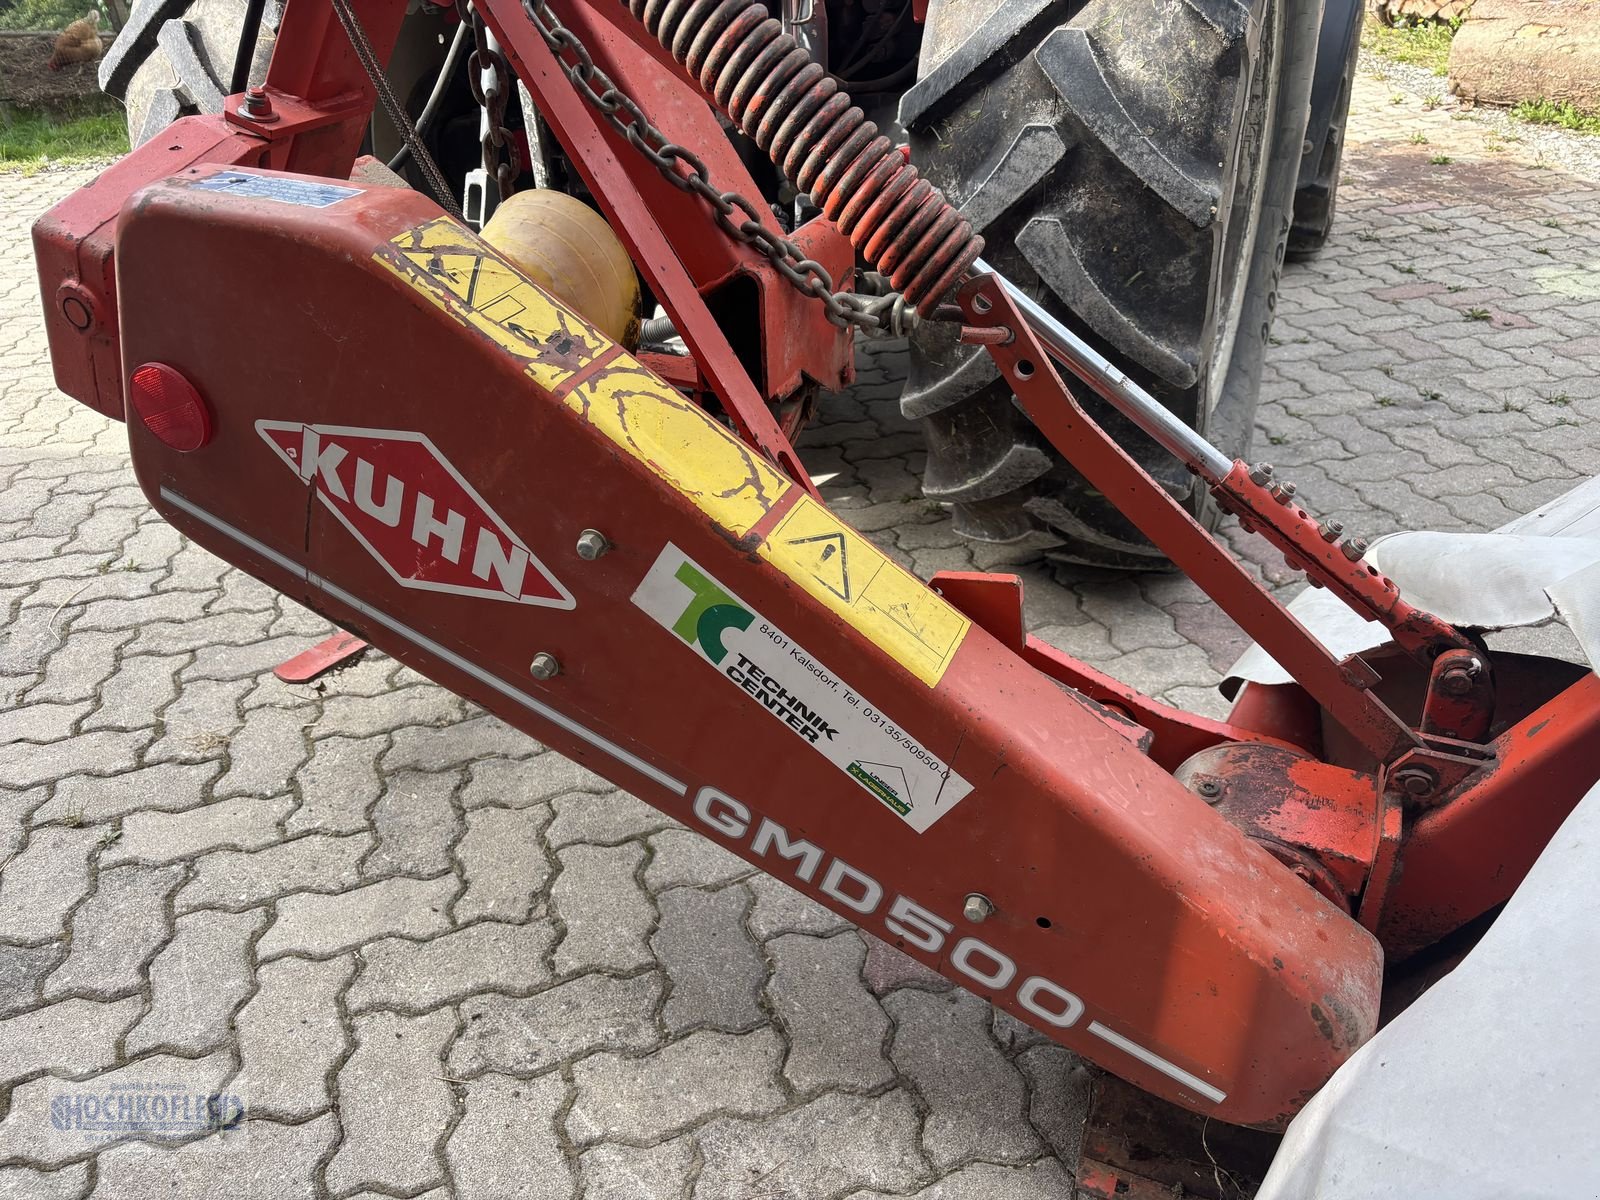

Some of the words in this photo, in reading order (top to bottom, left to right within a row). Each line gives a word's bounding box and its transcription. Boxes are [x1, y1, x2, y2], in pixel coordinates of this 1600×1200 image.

[300, 425, 530, 600] KUHN
[672, 560, 756, 666] TC
[726, 665, 821, 744] CENTER
[736, 652, 840, 742] TECHNIK
[759, 623, 789, 650] 8401
[789, 649, 839, 693] Kalsdorf,
[842, 689, 860, 710] Tel.
[862, 707, 950, 780] 03135/50950-0
[857, 772, 906, 813] LAGERHAUS
[869, 771, 898, 797] UNSER
